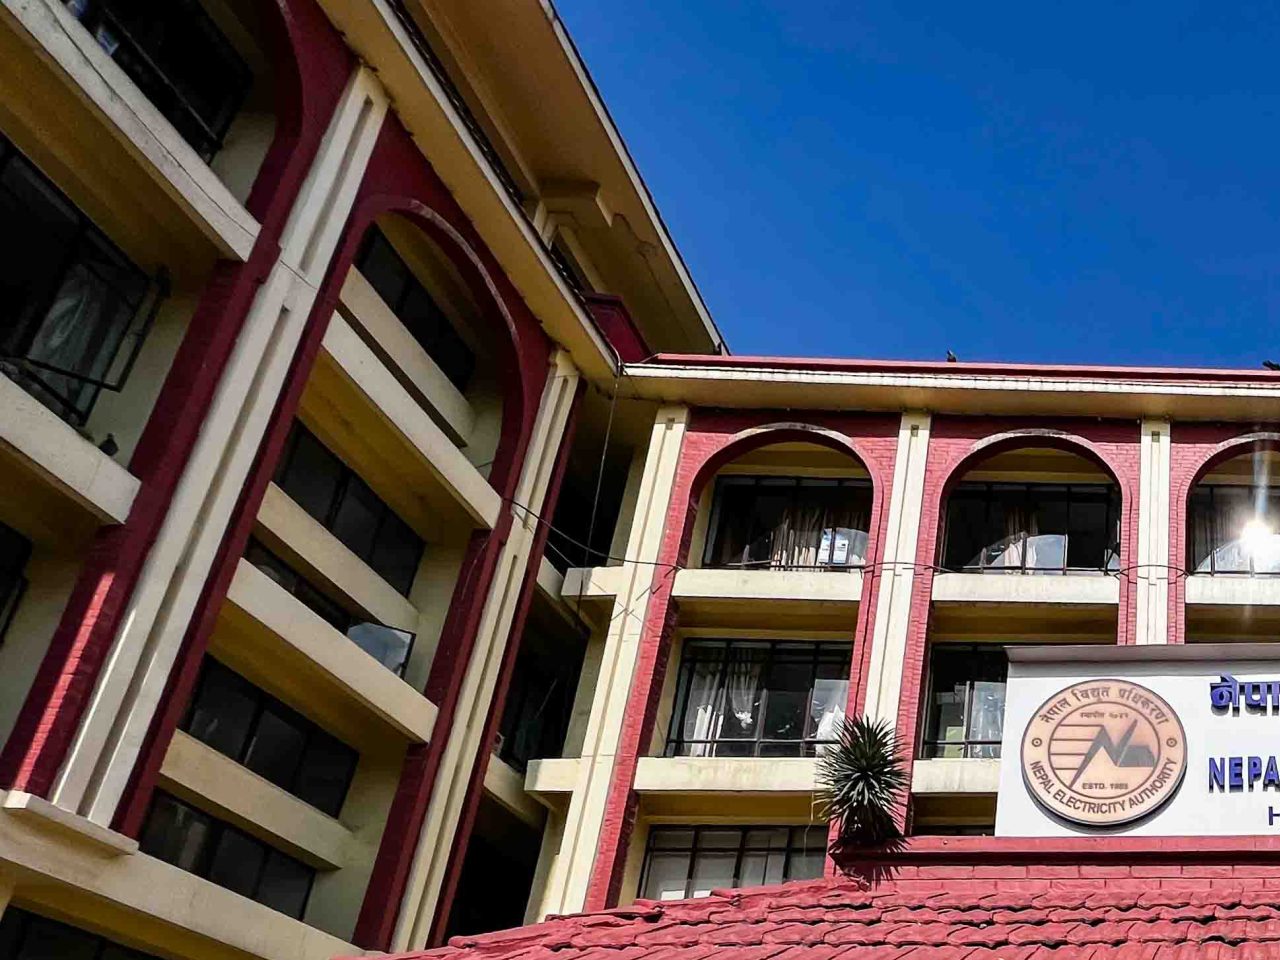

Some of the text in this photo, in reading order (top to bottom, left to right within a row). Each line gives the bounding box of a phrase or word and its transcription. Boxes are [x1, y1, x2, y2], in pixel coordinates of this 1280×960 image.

[1030, 758, 1178, 815] NEPAL ELECTRICITY AUTHORITY
